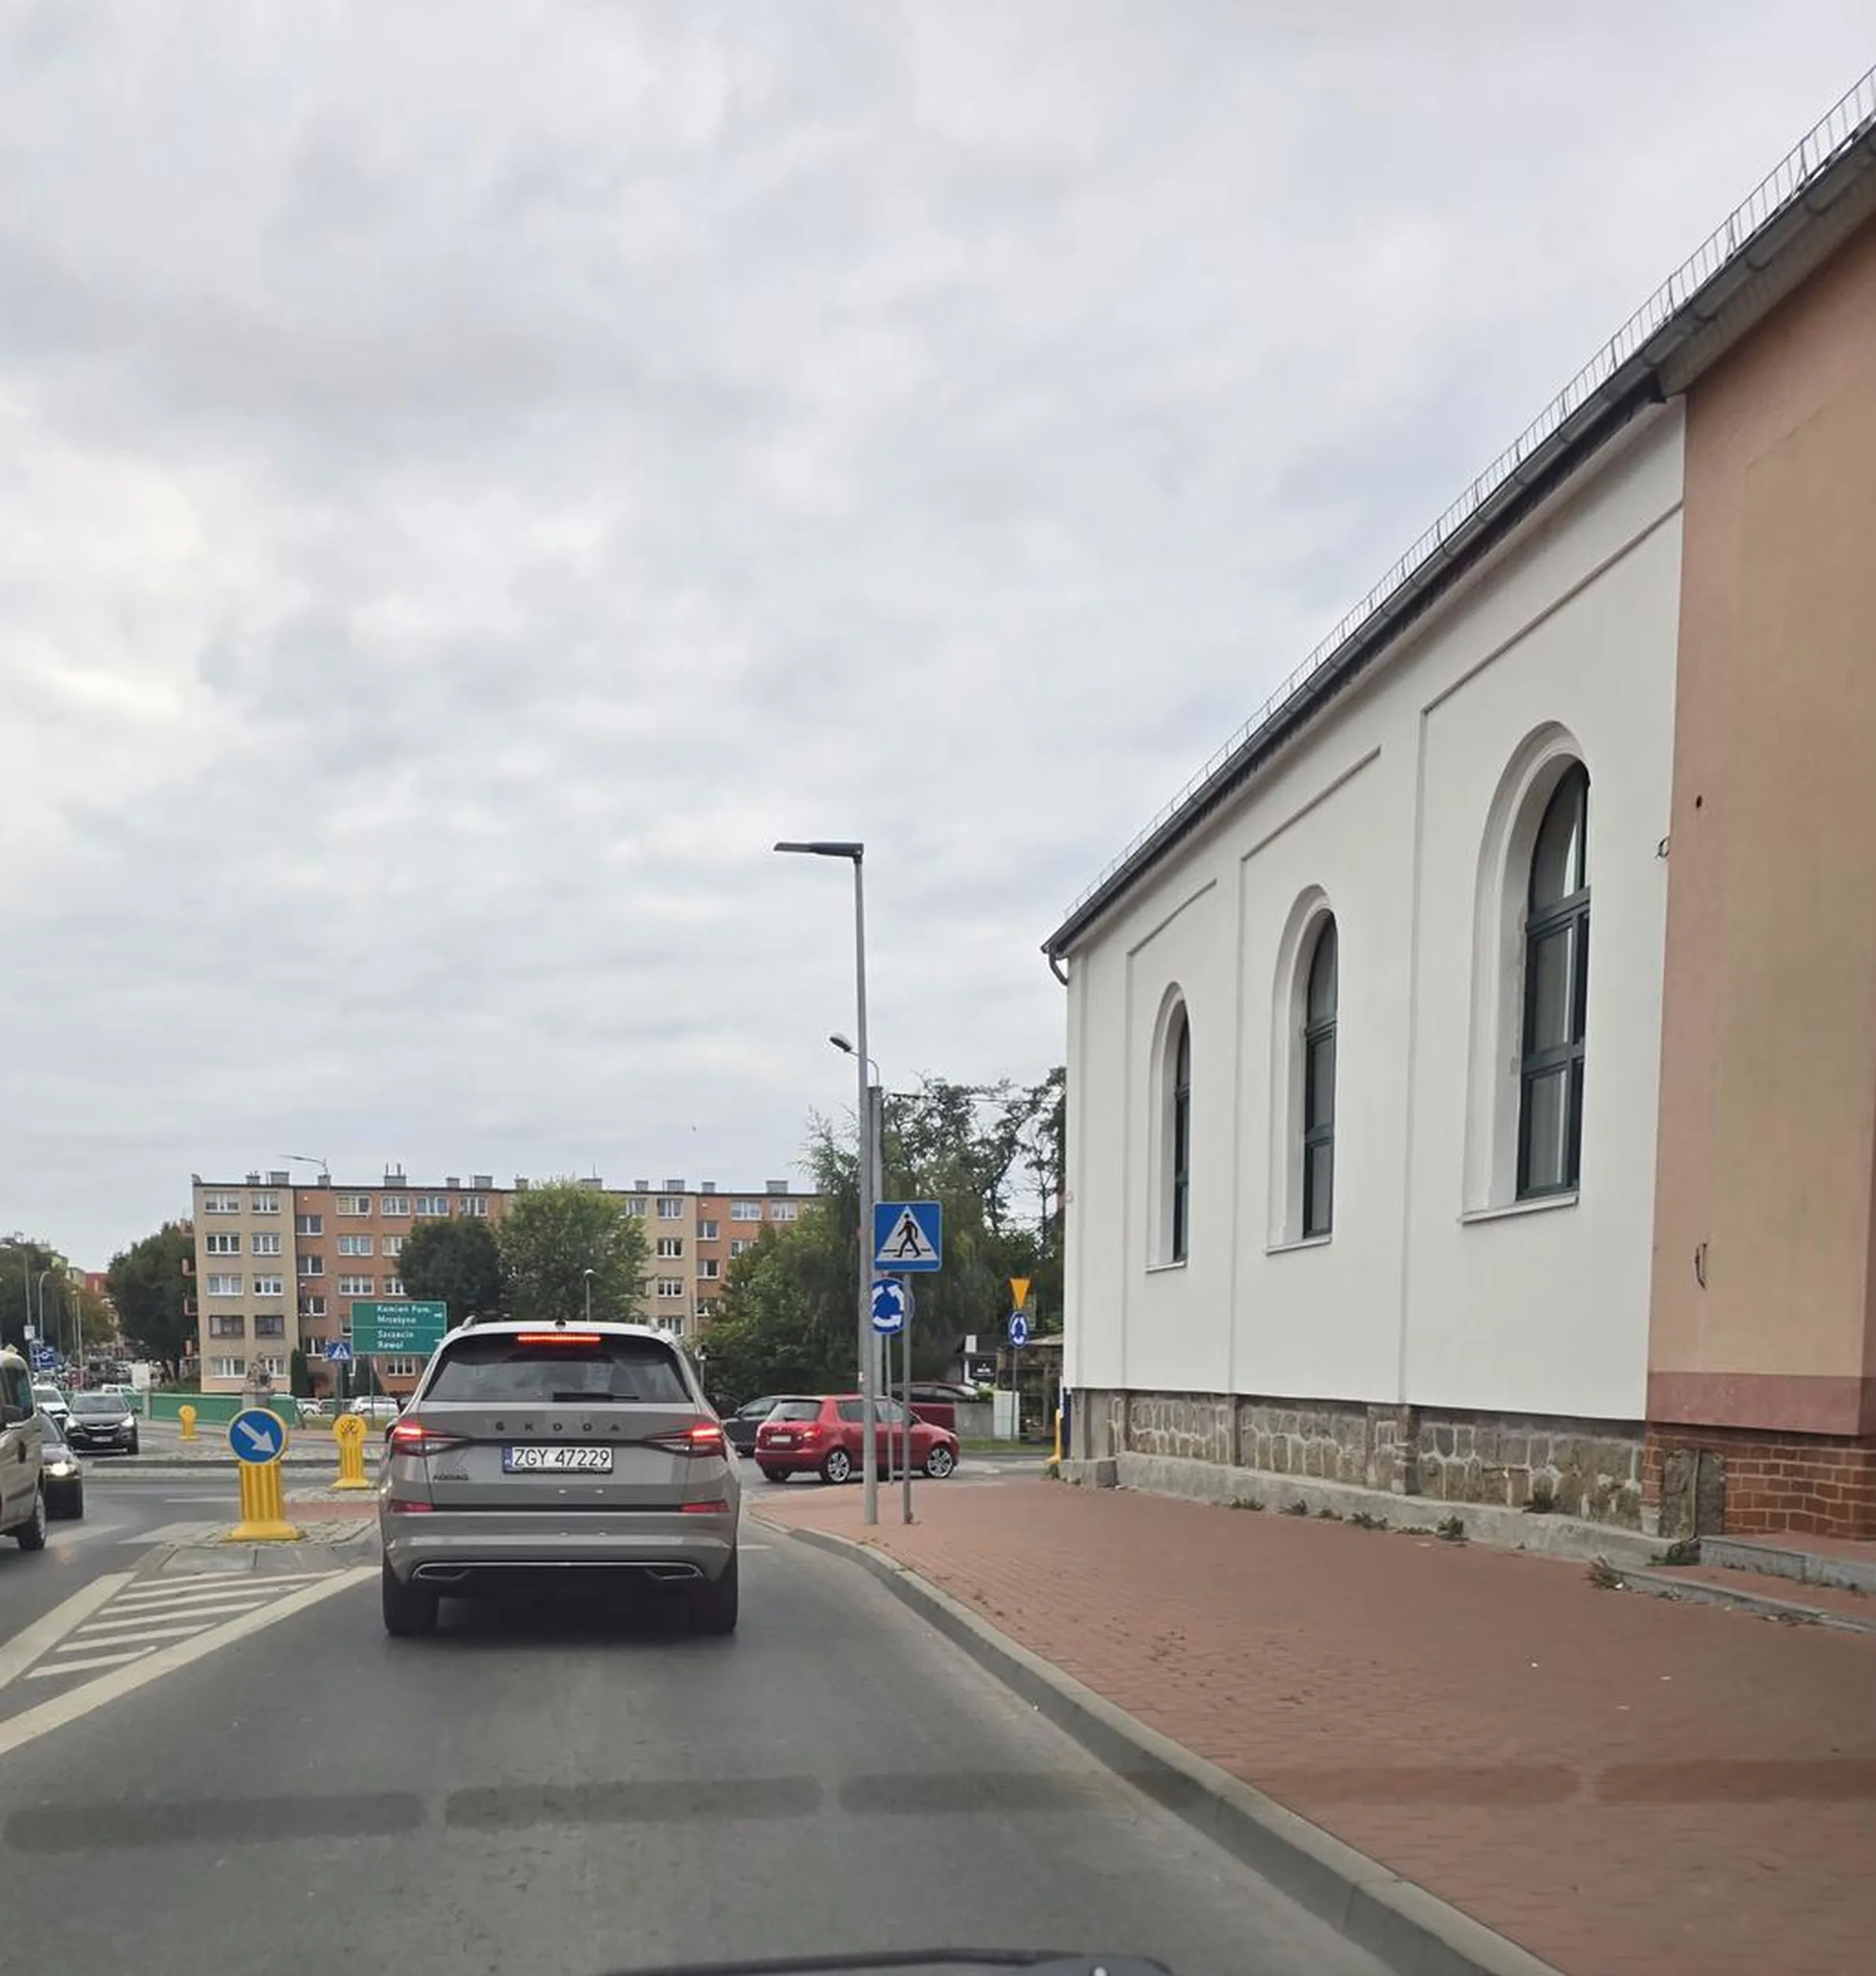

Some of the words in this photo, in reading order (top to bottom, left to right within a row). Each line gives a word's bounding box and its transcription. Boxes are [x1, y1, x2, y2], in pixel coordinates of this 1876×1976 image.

[378, 1329, 413, 1338] Szczecin
[514, 1449, 547, 1466] ZGY
[555, 1449, 610, 1466] 47229
